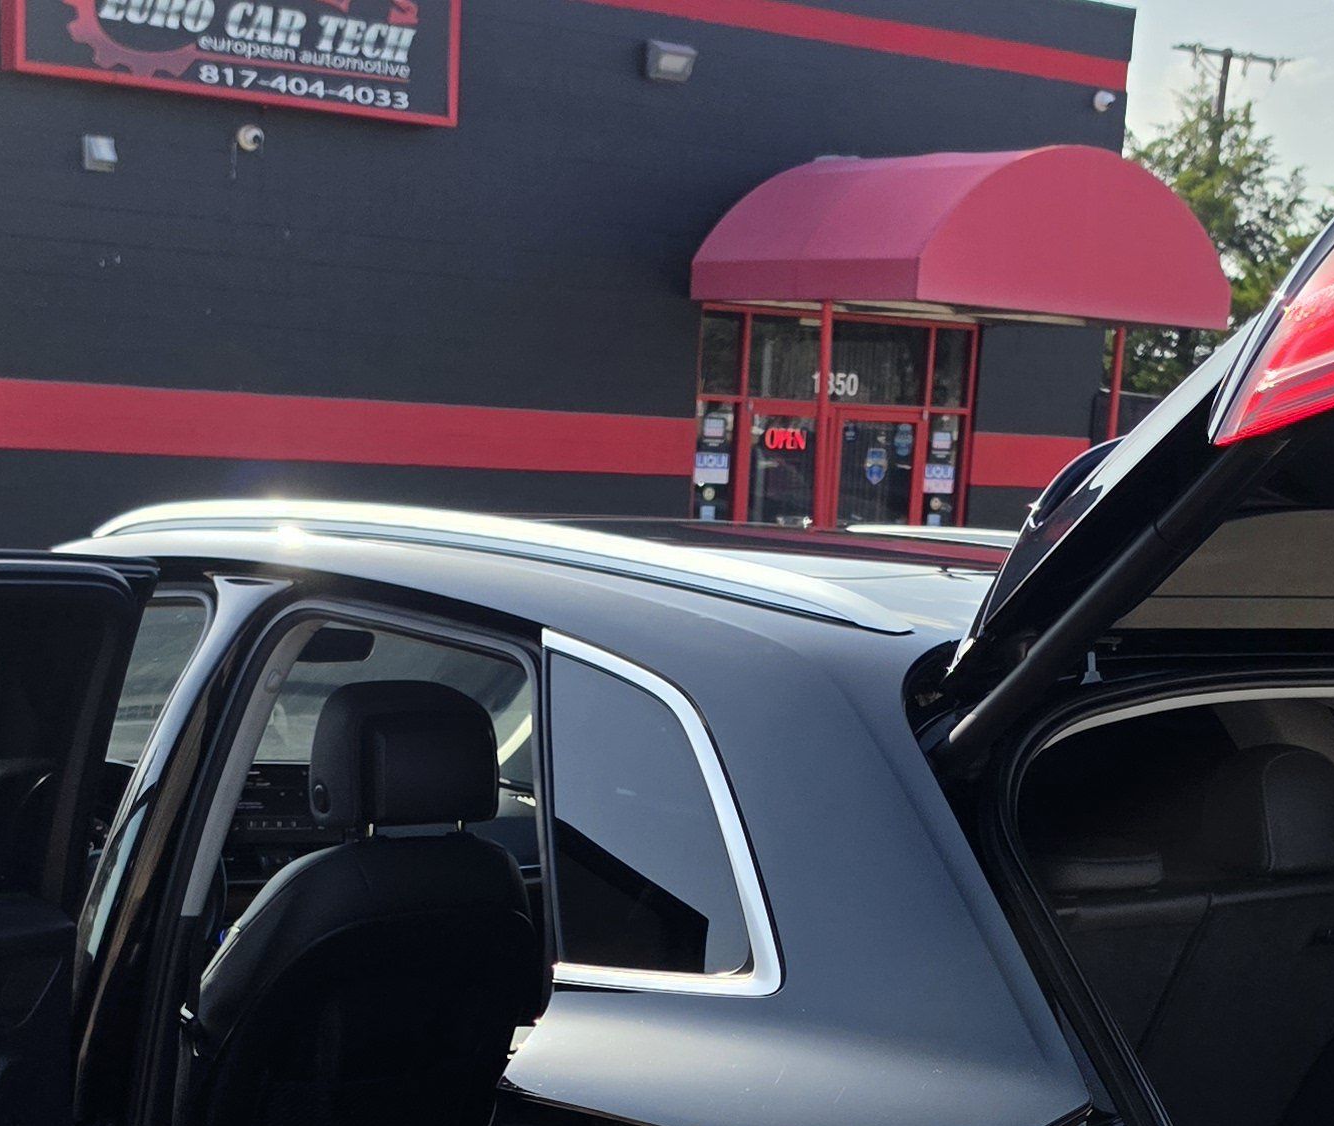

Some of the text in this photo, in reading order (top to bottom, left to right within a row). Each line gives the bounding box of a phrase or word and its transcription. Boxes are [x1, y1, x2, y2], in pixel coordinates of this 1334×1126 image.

[225, 2, 306, 47] CAR
[317, 15, 416, 63] TECH
[198, 36, 410, 78] european automotive
[198, 64, 410, 110] 817-404-4033
[765, 428, 807, 449] OPEN
